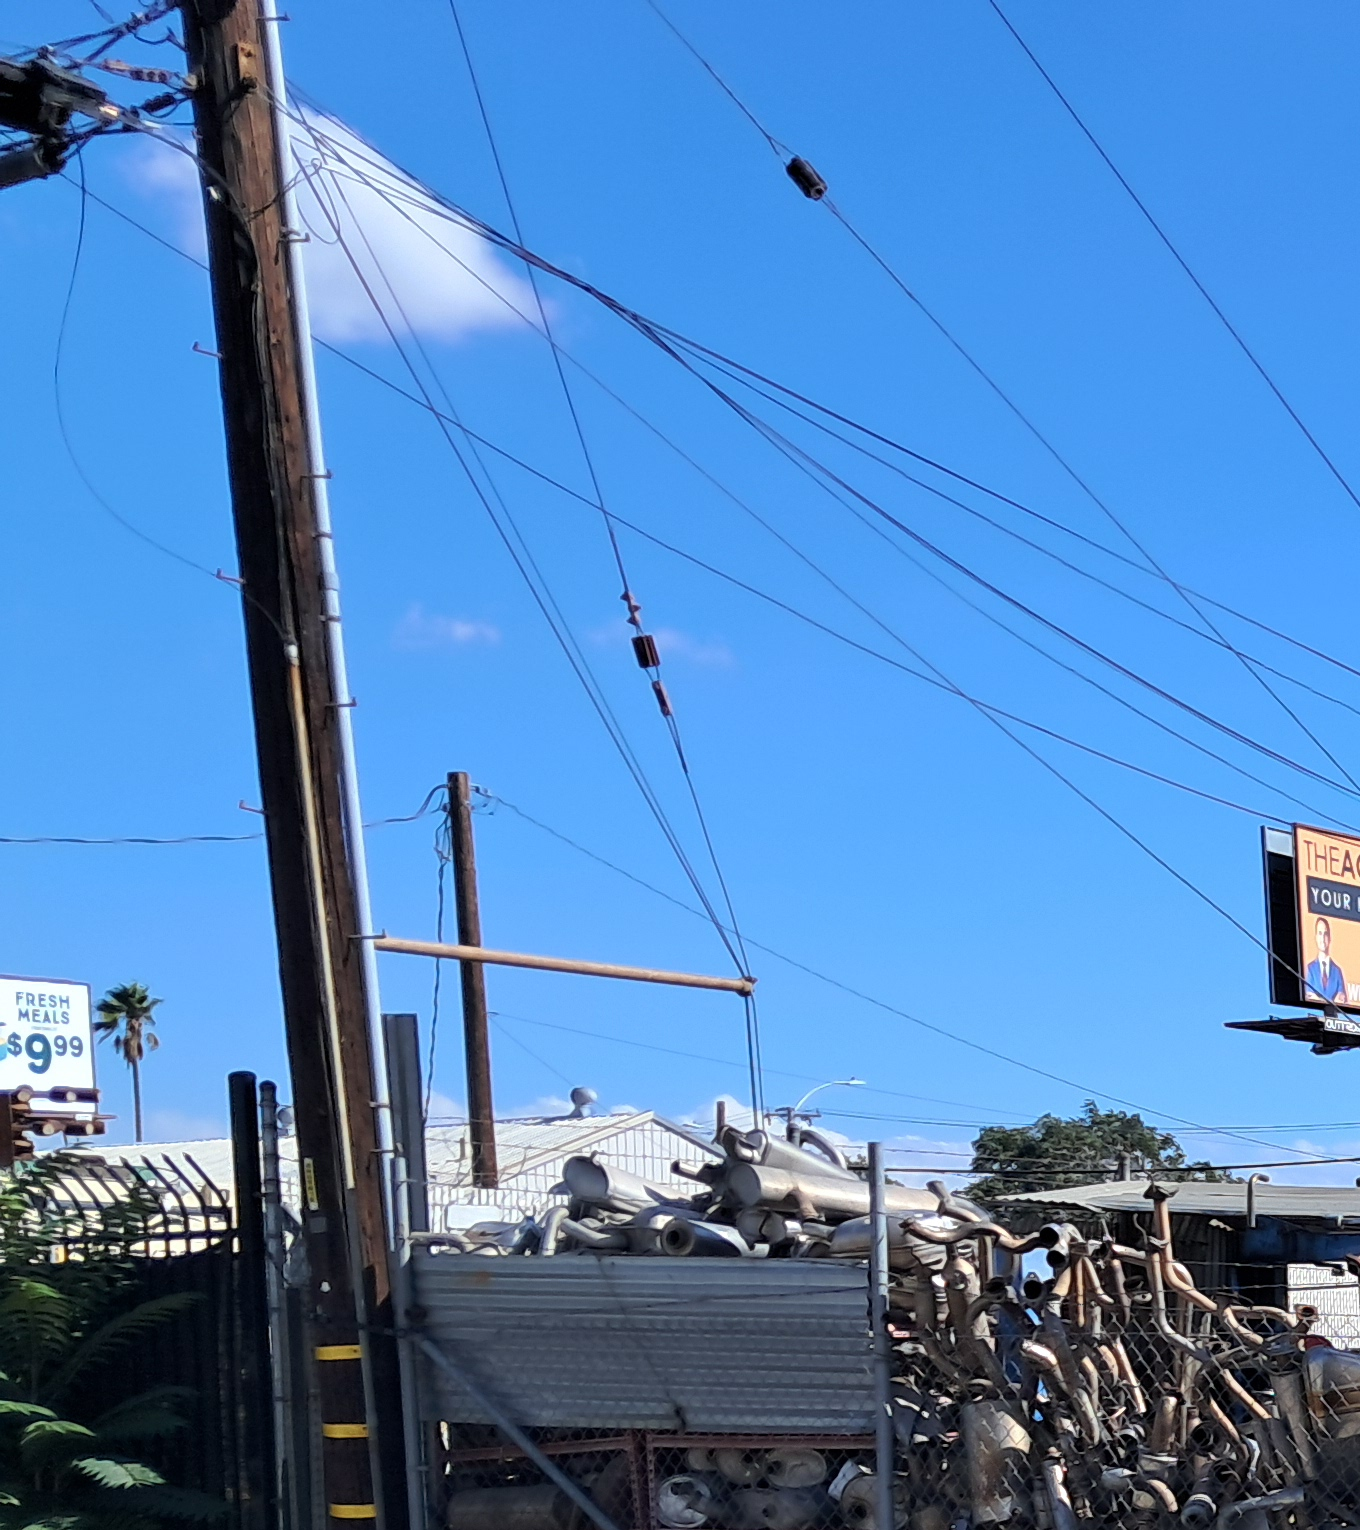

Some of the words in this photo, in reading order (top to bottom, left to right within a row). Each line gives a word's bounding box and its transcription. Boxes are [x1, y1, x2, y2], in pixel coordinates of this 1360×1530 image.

[1311, 886, 1351, 911] YOUR
[15, 991, 70, 1010] FRESH
[17, 1008, 70, 1025] MEALS
